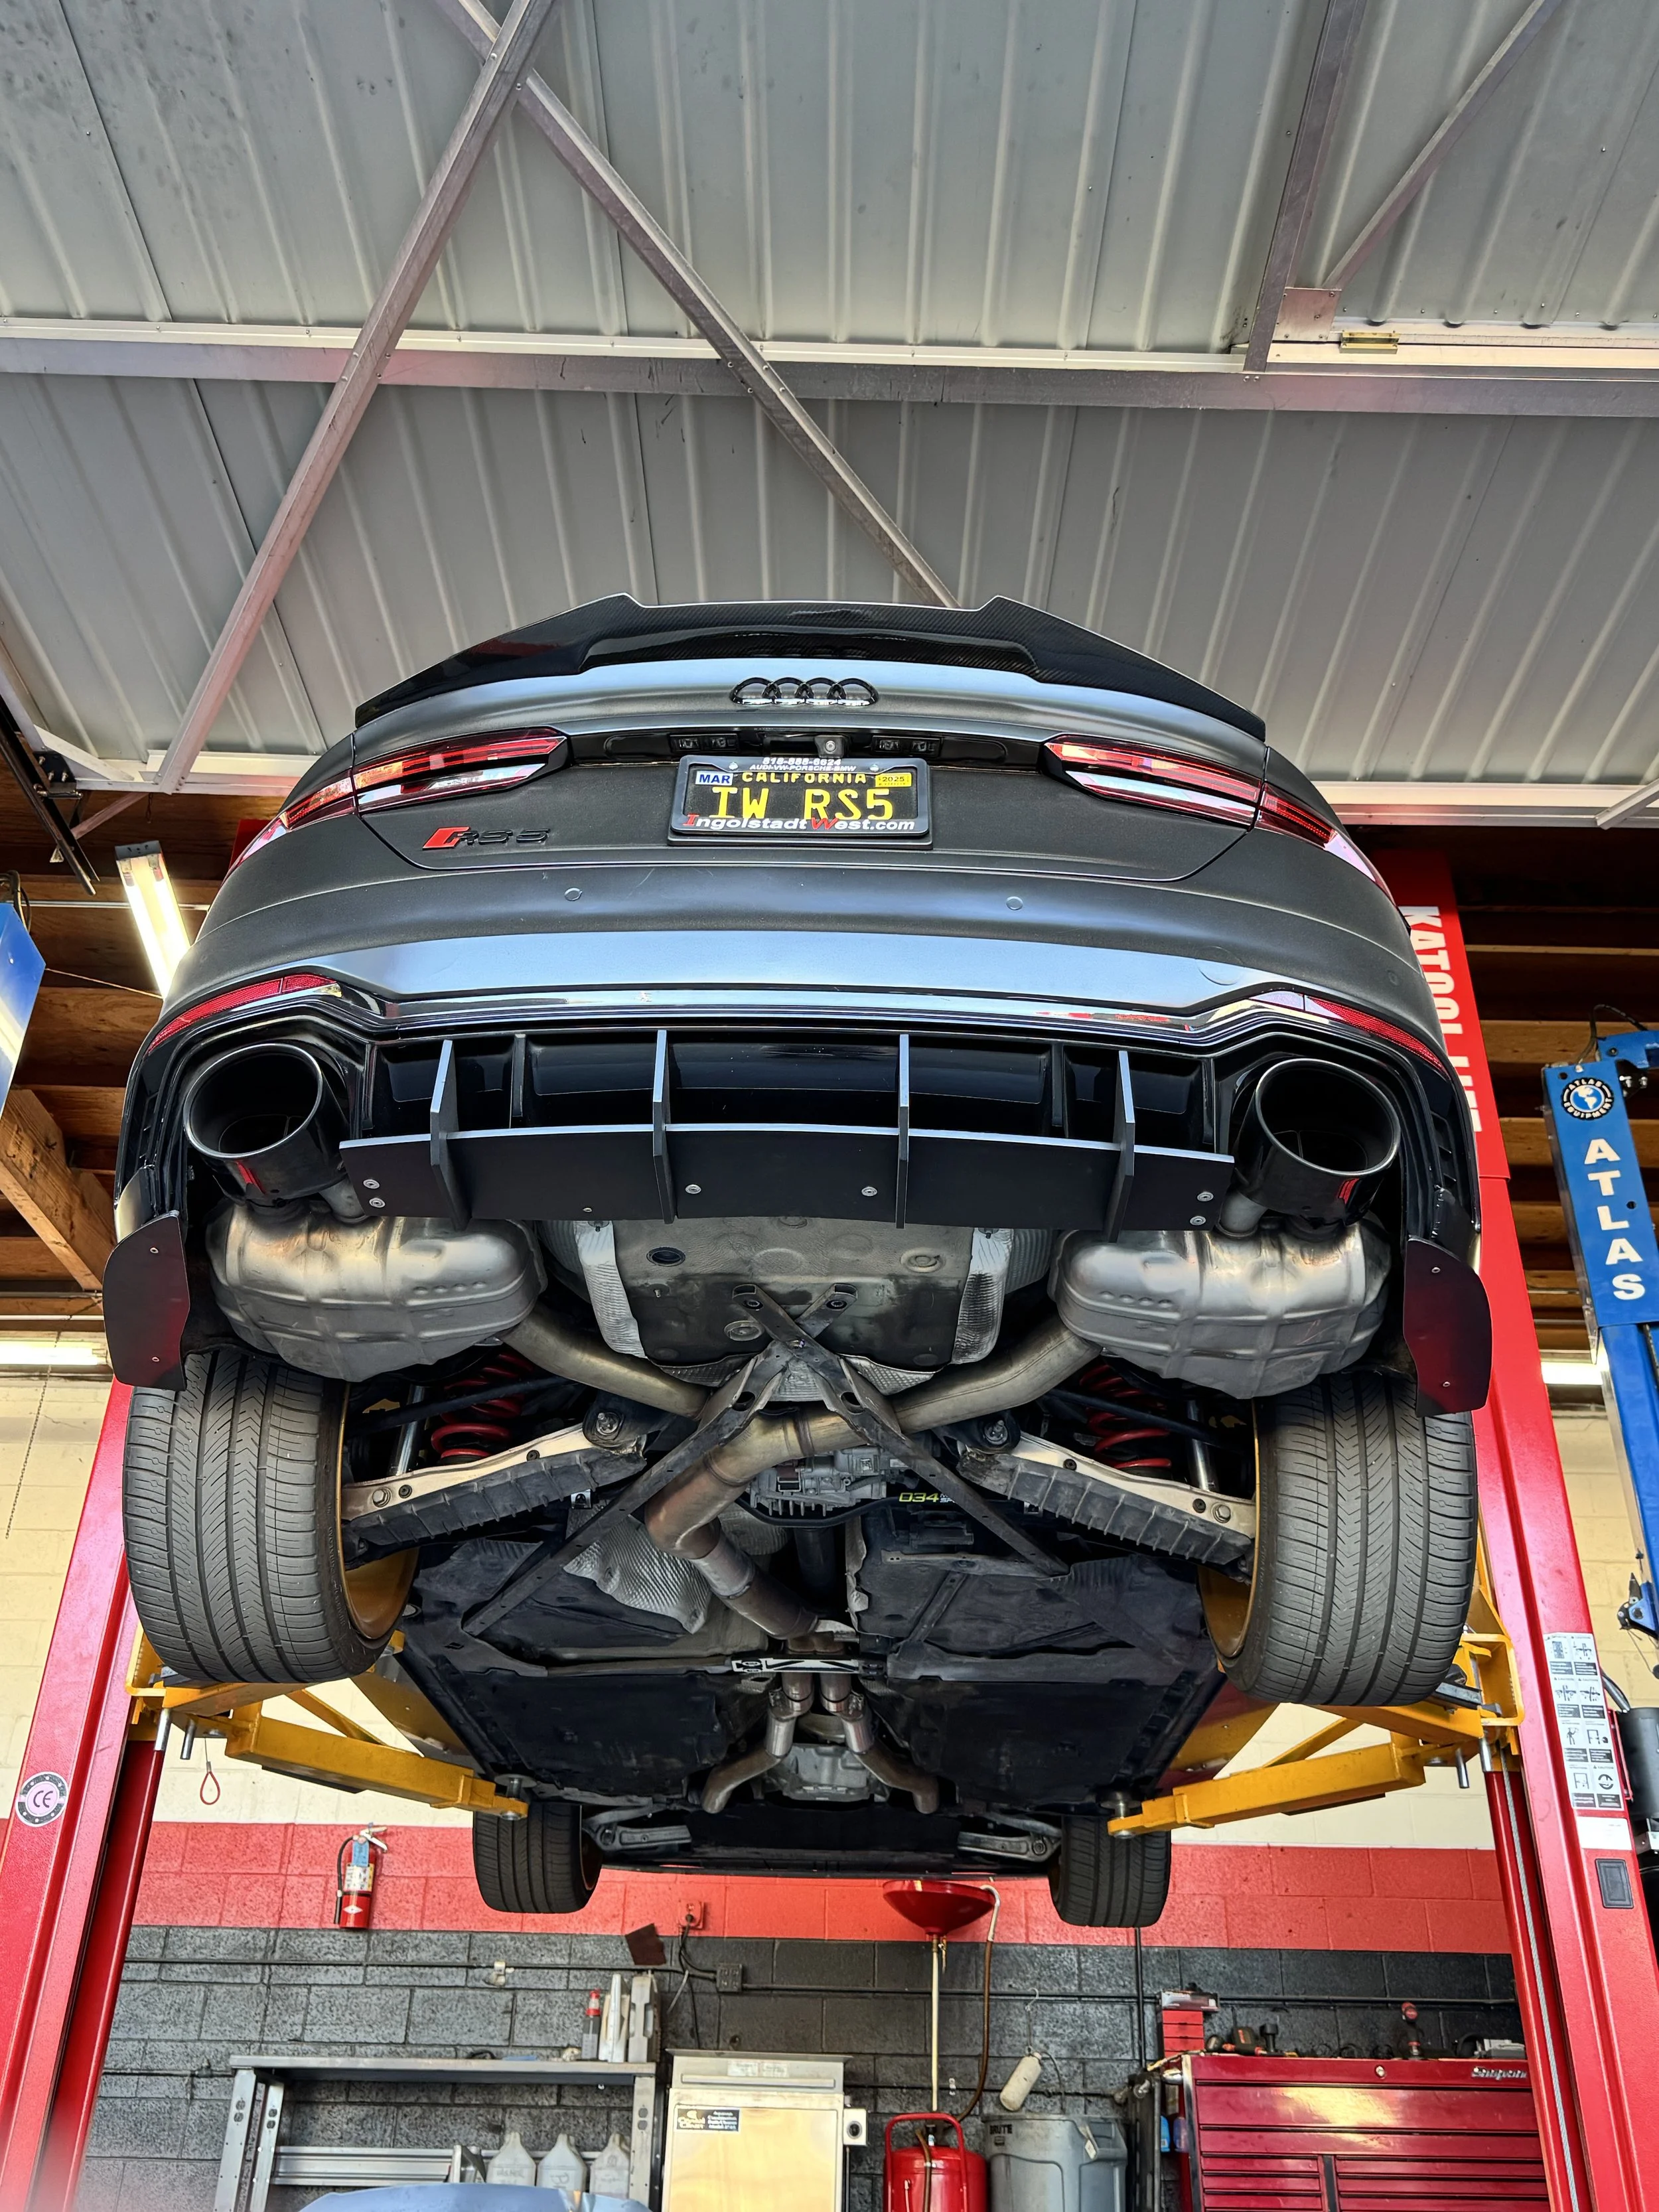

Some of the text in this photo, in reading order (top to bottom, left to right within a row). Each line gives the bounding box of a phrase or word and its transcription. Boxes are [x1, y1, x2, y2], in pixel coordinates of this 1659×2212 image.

[698, 774, 731, 784] MAR
[742, 772, 867, 784] CALIFORNIA
[708, 787, 893, 820] IW RS5
[682, 814, 915, 831] IngolstadtWest.com
[1568, 1078, 1603, 1090] ATLAS
[1563, 1098, 1613, 1120] EQUIPMENT
[1584, 1138, 1646, 1301] ATLAS
[899, 1492, 939, 1503] 034
[33, 1790, 53, 1808] CE
